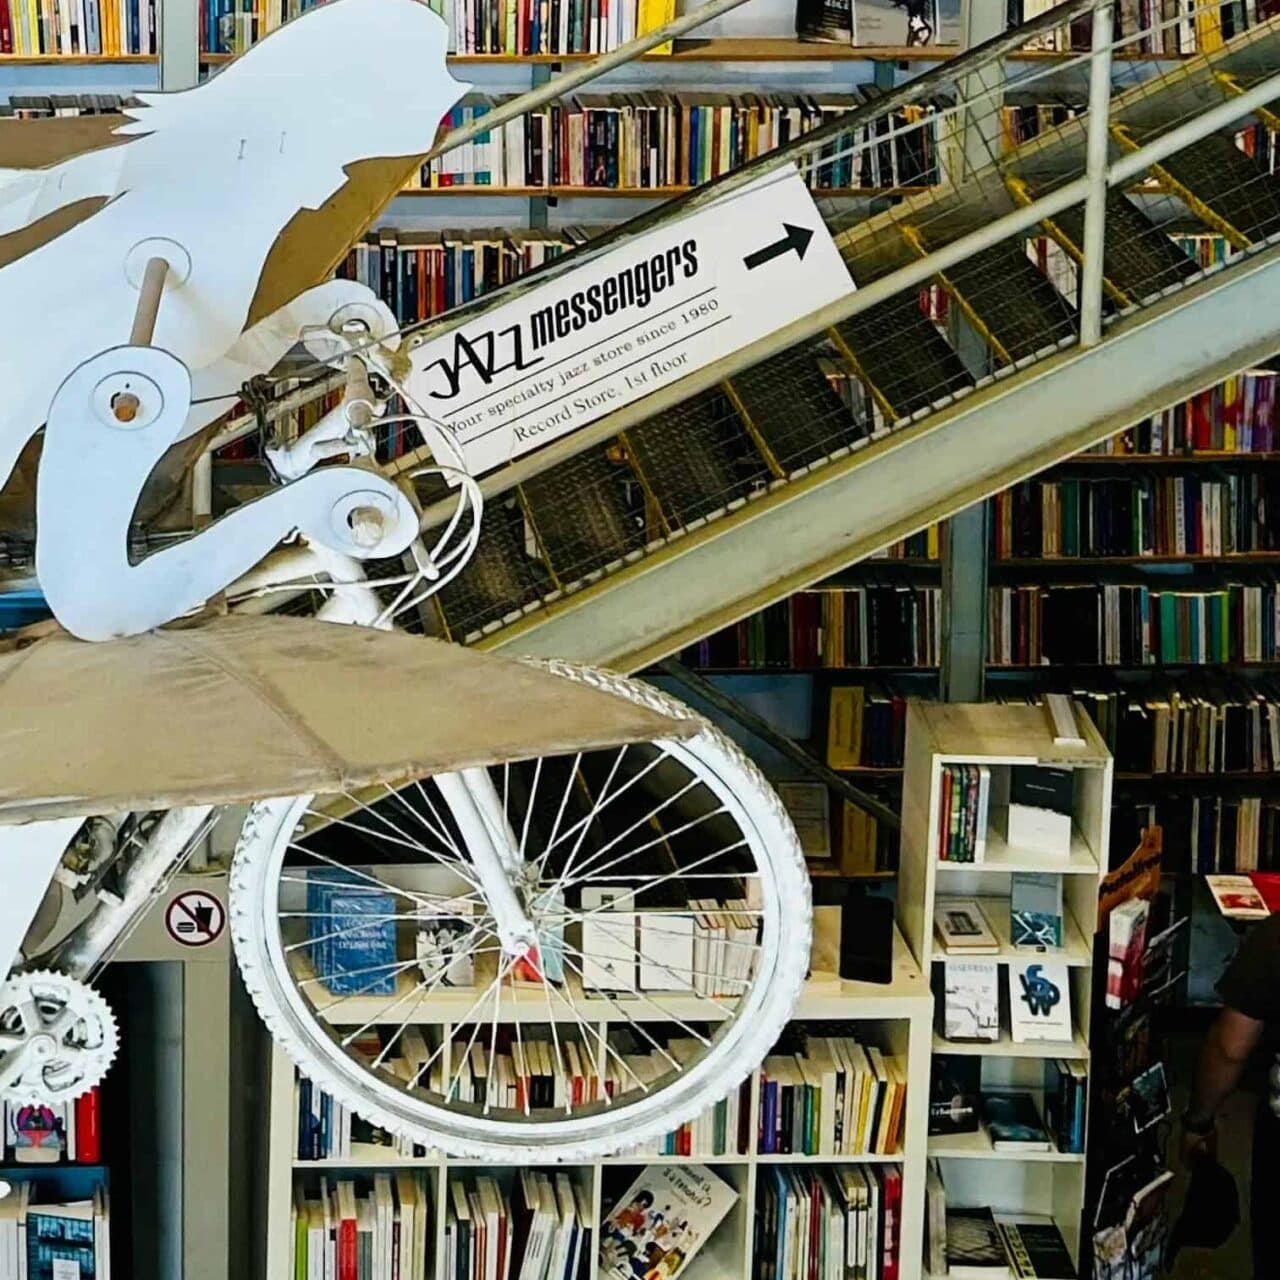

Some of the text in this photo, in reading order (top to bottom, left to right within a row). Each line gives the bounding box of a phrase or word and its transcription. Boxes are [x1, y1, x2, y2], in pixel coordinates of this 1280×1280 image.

[531, 239, 699, 350] messengers
[447, 298, 720, 435] Your specialty jazz store since 1980
[512, 408, 573, 443] Record
[650, 350, 690, 381] floor
